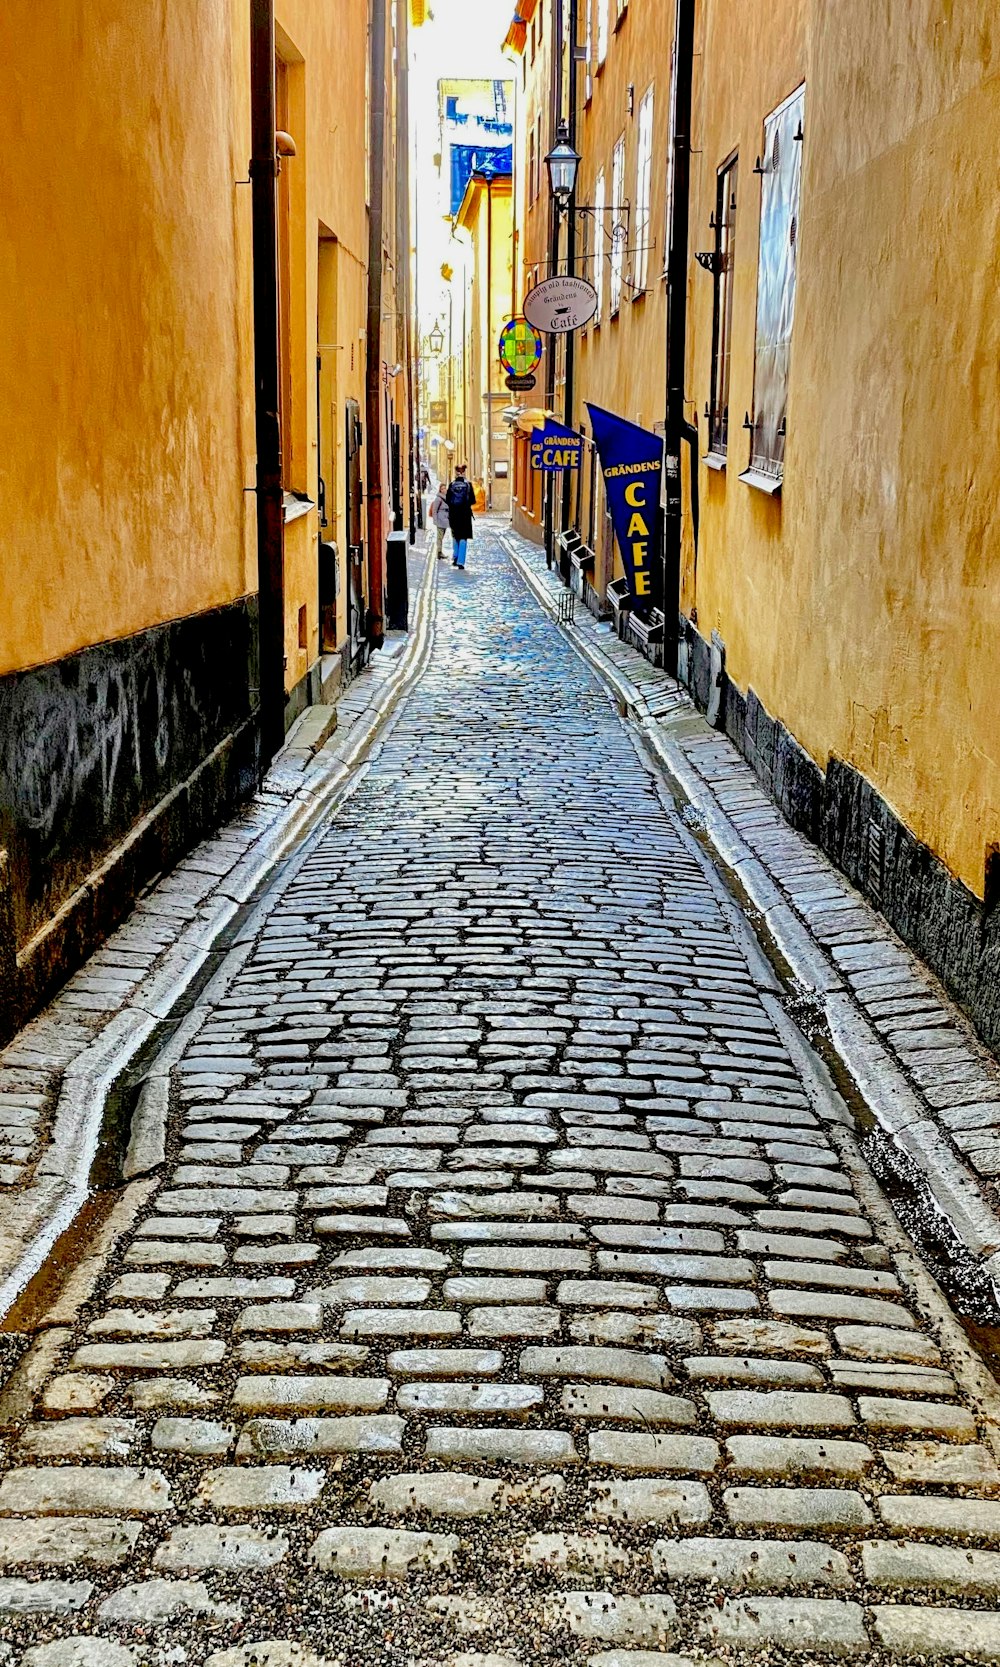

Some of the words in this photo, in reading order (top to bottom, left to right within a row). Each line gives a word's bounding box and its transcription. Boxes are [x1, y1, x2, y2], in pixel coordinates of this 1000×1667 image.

[528, 285, 548, 306] simply
[548, 280, 560, 290] old
[562, 279, 595, 299] fashioned
[550, 314, 578, 330] Café
[543, 435, 580, 447] GRÄNDENS
[542, 449, 580, 466] CAFE
[604, 460, 661, 478] GRÄNDENS
[624, 481, 651, 596] CAFE
